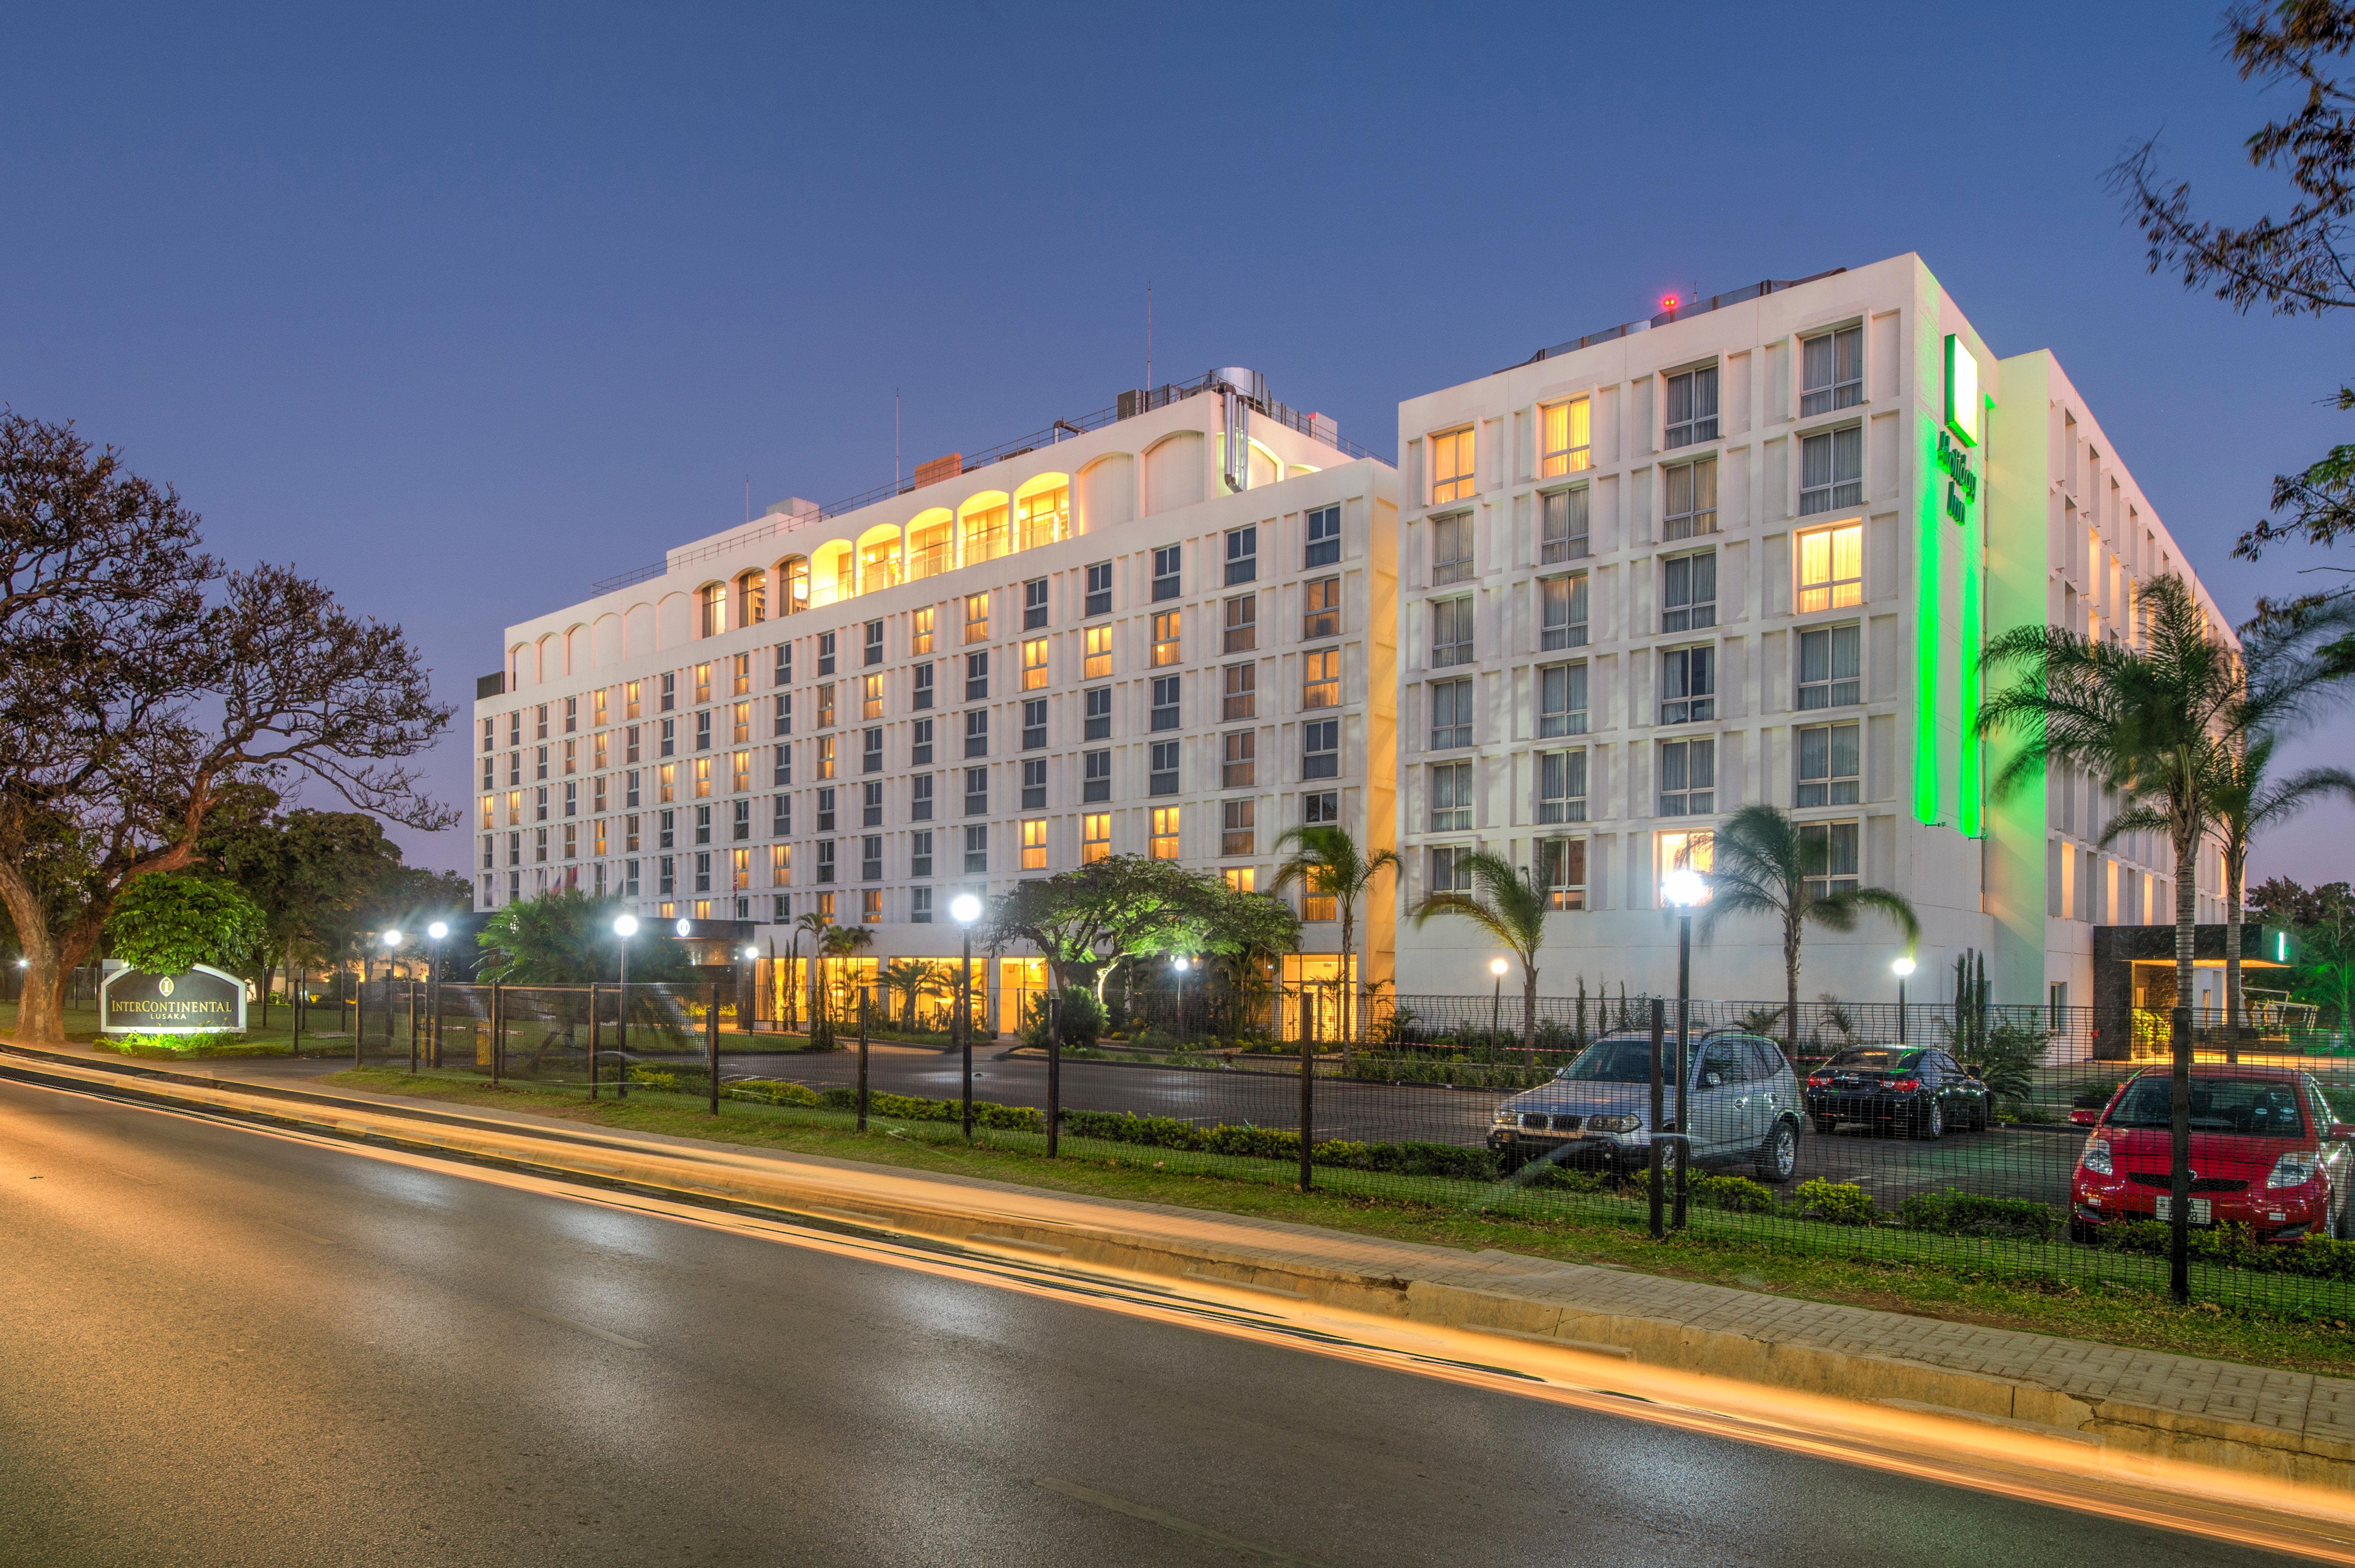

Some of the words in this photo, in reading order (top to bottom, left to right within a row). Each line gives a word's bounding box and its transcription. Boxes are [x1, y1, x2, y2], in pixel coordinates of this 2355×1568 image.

[1938, 431, 1977, 503] Holiday
[1947, 481, 1965, 526] Inn
[112, 1000, 232, 1012] INTERCONTINENTAL
